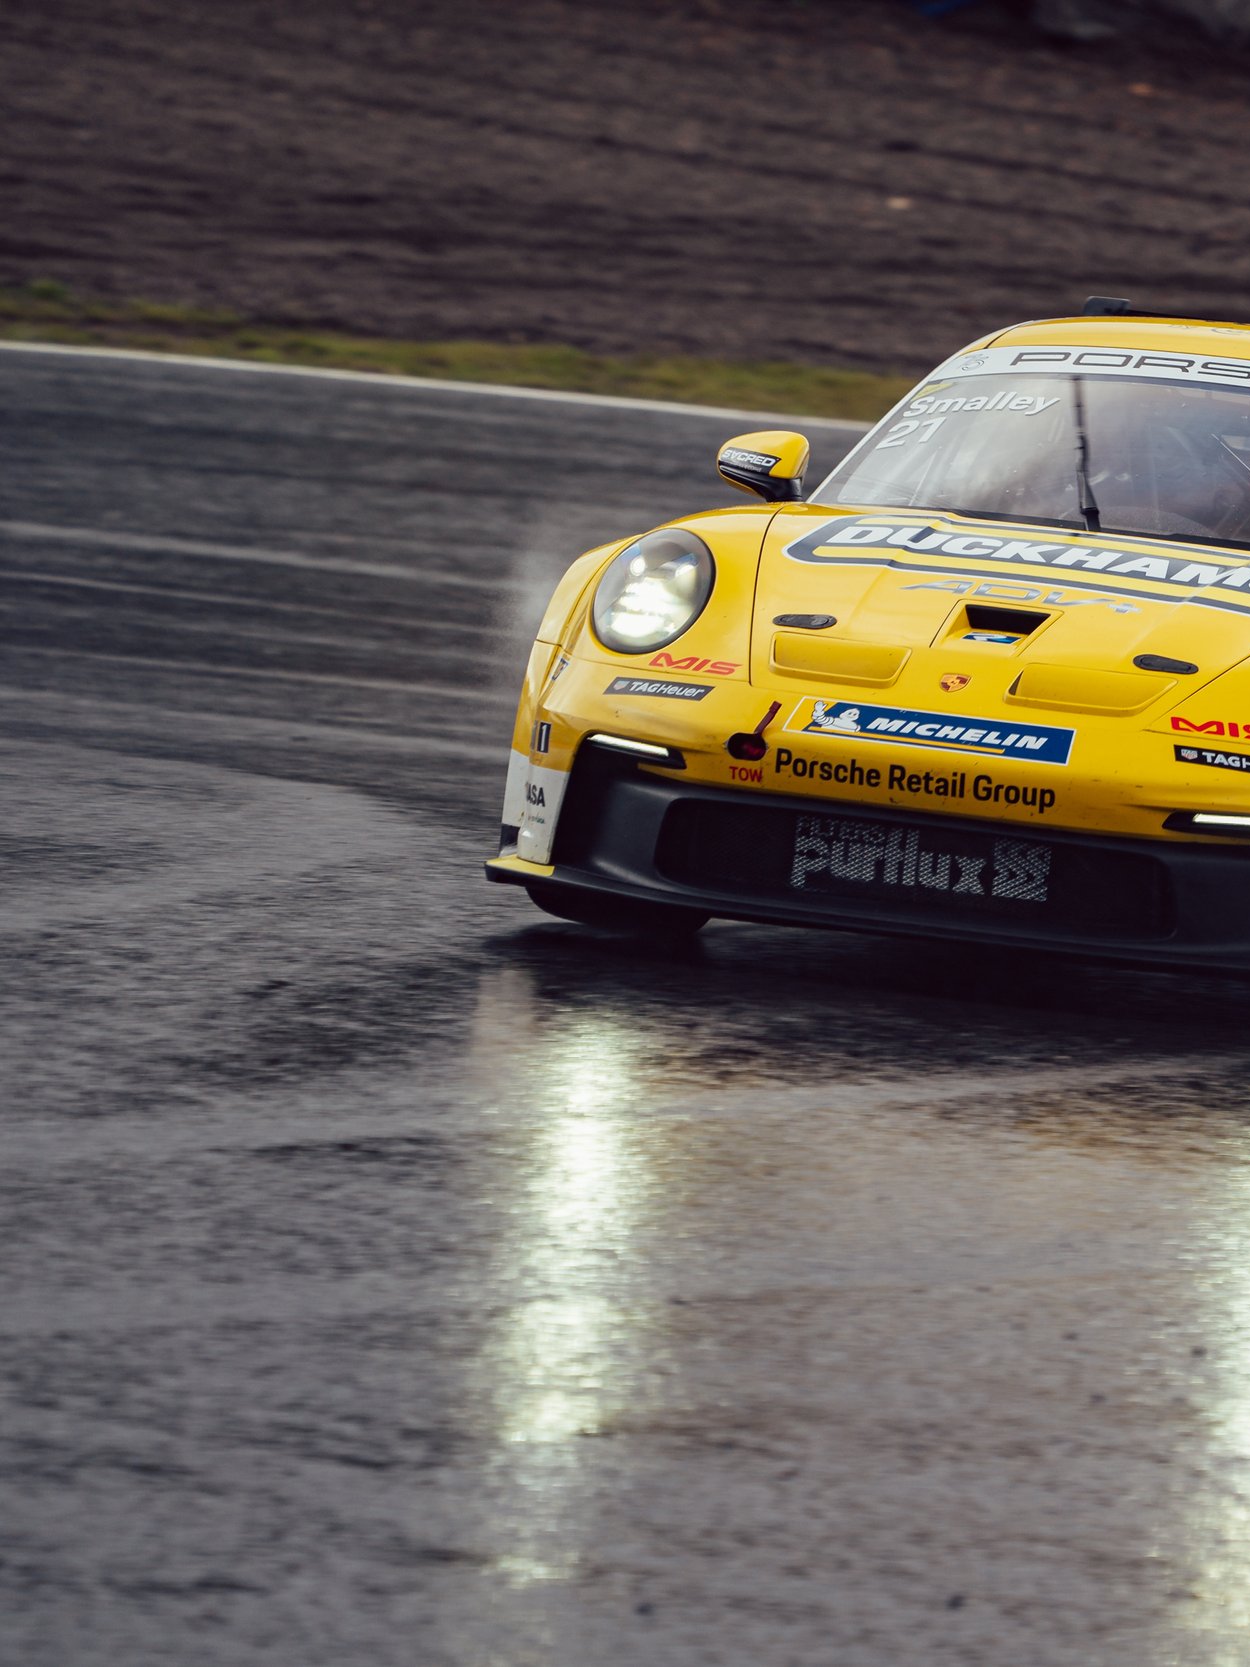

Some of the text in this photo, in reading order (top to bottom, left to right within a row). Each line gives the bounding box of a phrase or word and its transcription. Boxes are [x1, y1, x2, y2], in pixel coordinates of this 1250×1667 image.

[903, 391, 1062, 418] Smalley
[876, 417, 947, 450] 21
[722, 449, 776, 467] SACRED
[866, 717, 1048, 750] MICHELIN
[729, 766, 763, 783] TOW
[775, 747, 1056, 814] Porsche Retail Group
